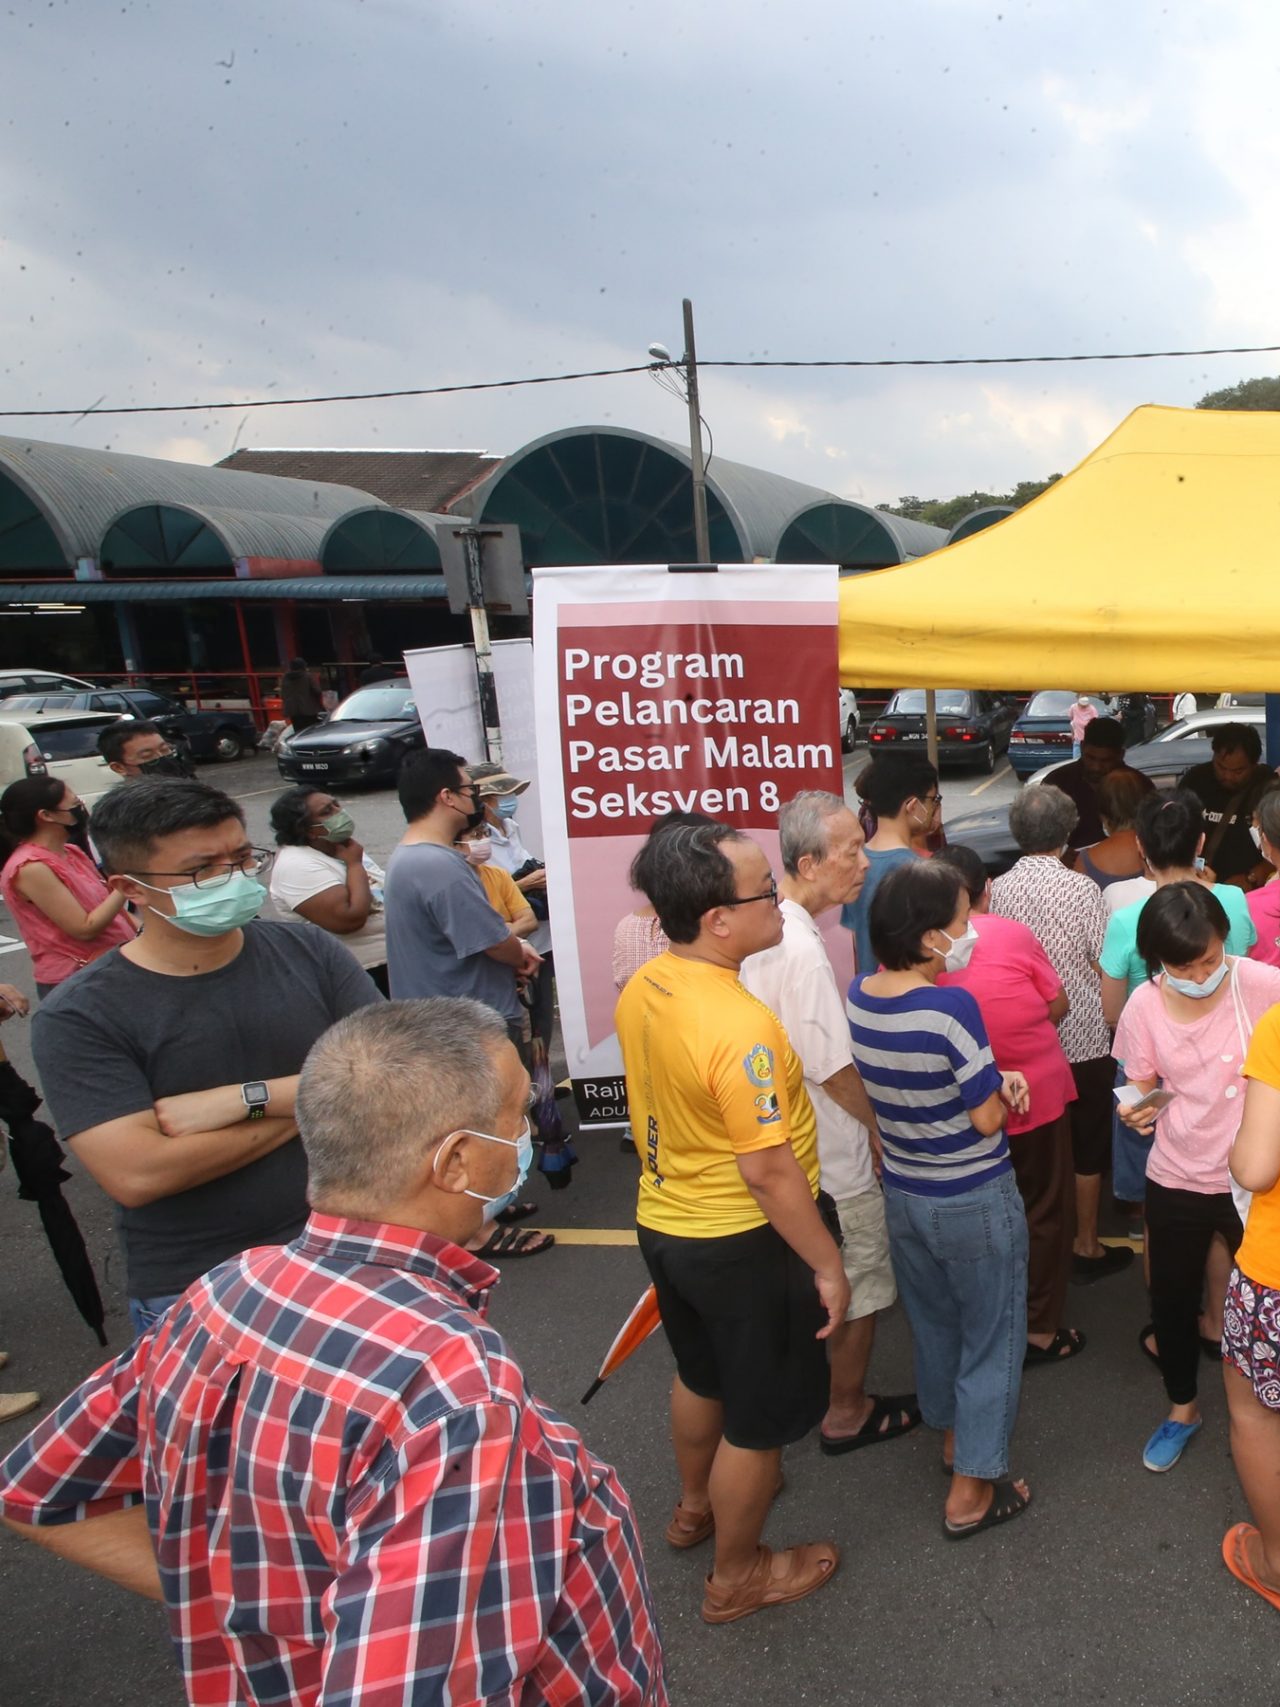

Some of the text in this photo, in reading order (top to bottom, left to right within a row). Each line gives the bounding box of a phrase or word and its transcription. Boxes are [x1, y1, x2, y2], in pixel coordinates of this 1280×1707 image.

[564, 648, 744, 688] Program
[566, 691, 799, 727] Pelancaran
[568, 736, 833, 773] Pasar Malam
[759, 781, 780, 813] 8
[584, 1081, 626, 1101] Raji
[589, 1106, 630, 1118] ADU
